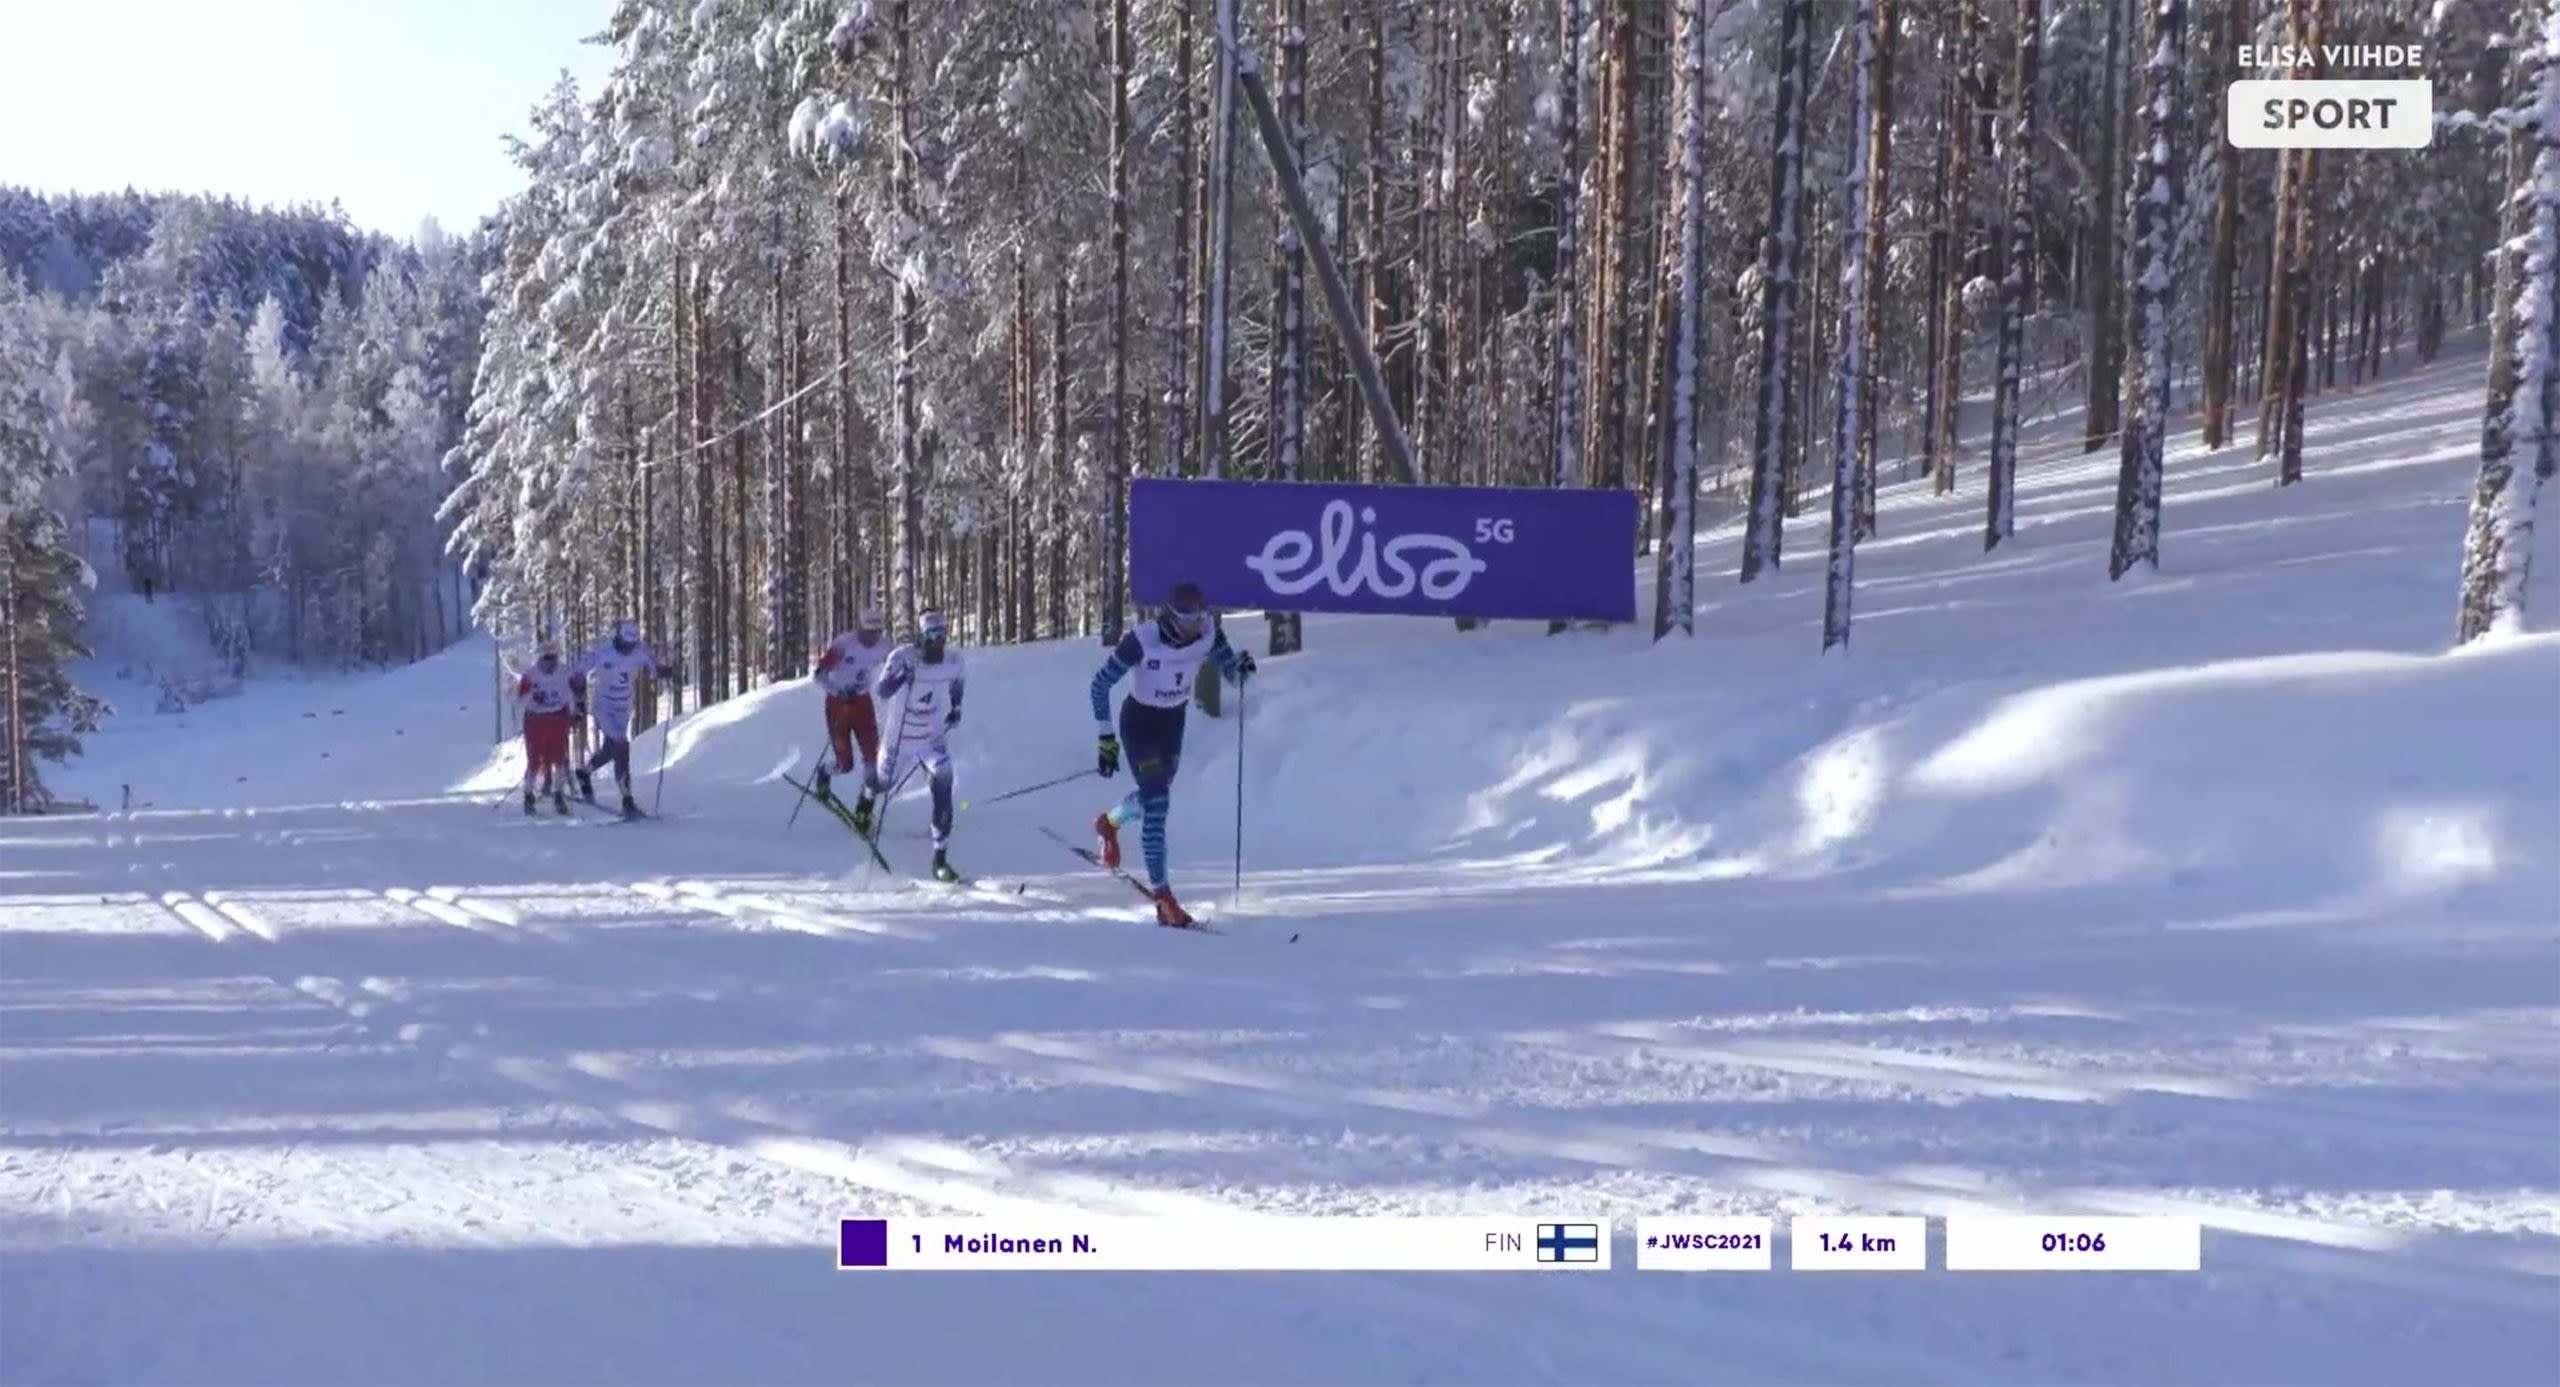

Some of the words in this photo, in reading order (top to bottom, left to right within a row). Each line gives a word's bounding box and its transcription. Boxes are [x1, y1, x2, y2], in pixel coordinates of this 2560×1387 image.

[1245, 499, 1487, 600] elisa
[1474, 517, 1515, 543] 5G
[918, 690, 934, 705] 4
